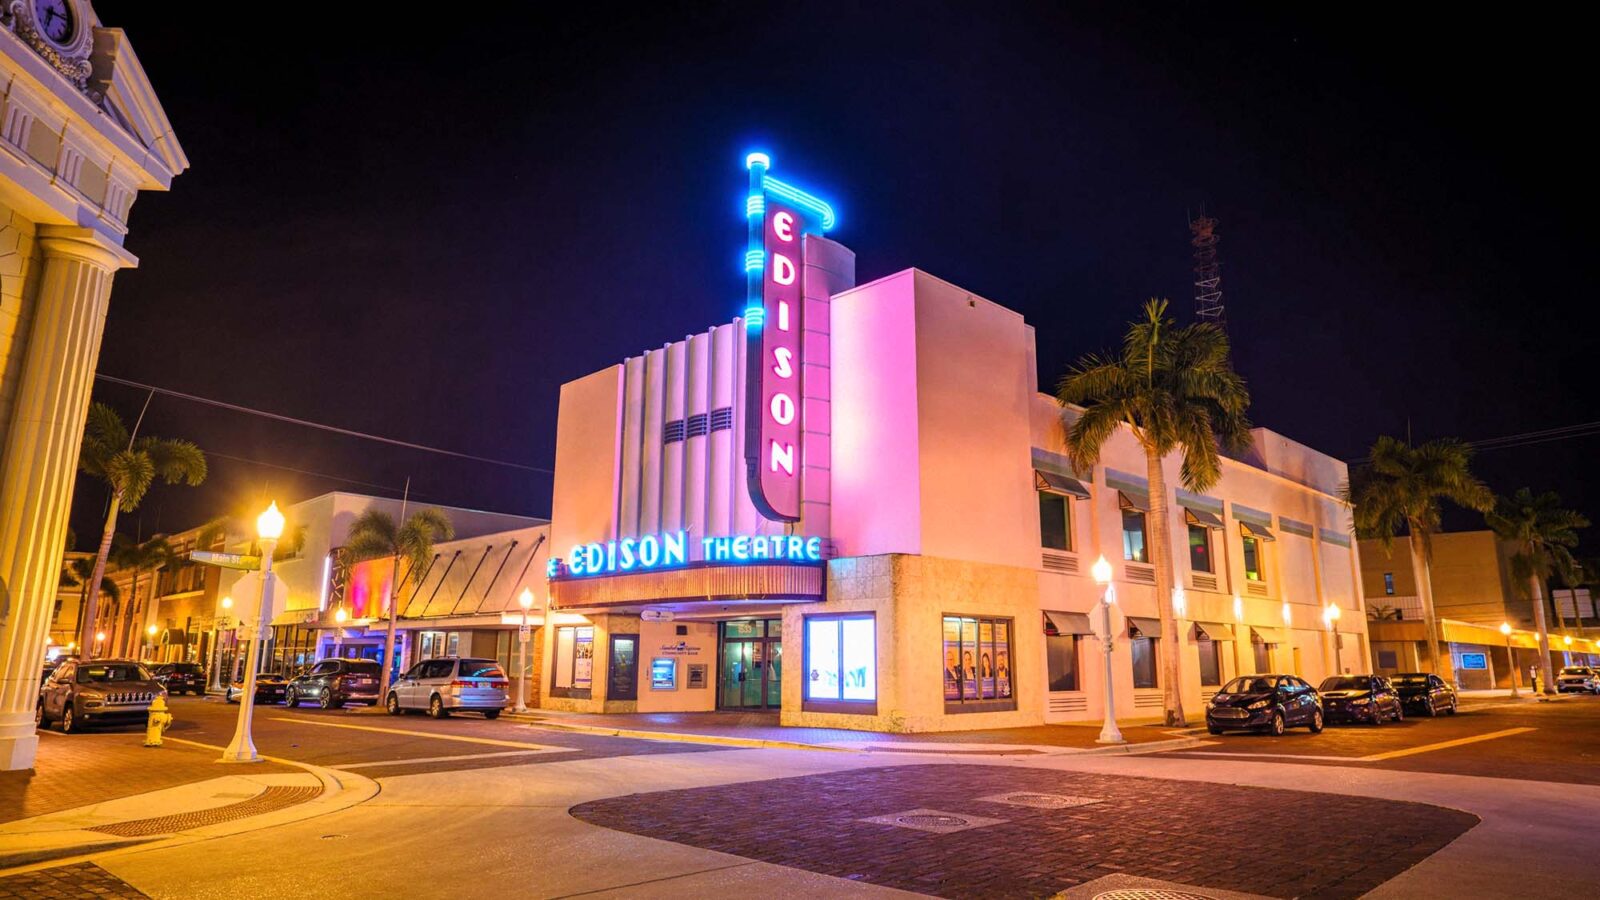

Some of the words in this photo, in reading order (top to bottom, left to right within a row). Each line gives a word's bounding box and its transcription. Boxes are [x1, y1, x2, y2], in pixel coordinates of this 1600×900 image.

[770, 211, 795, 476] EDISON
[569, 530, 685, 575] EDISON
[702, 535, 821, 560] THEATRE
